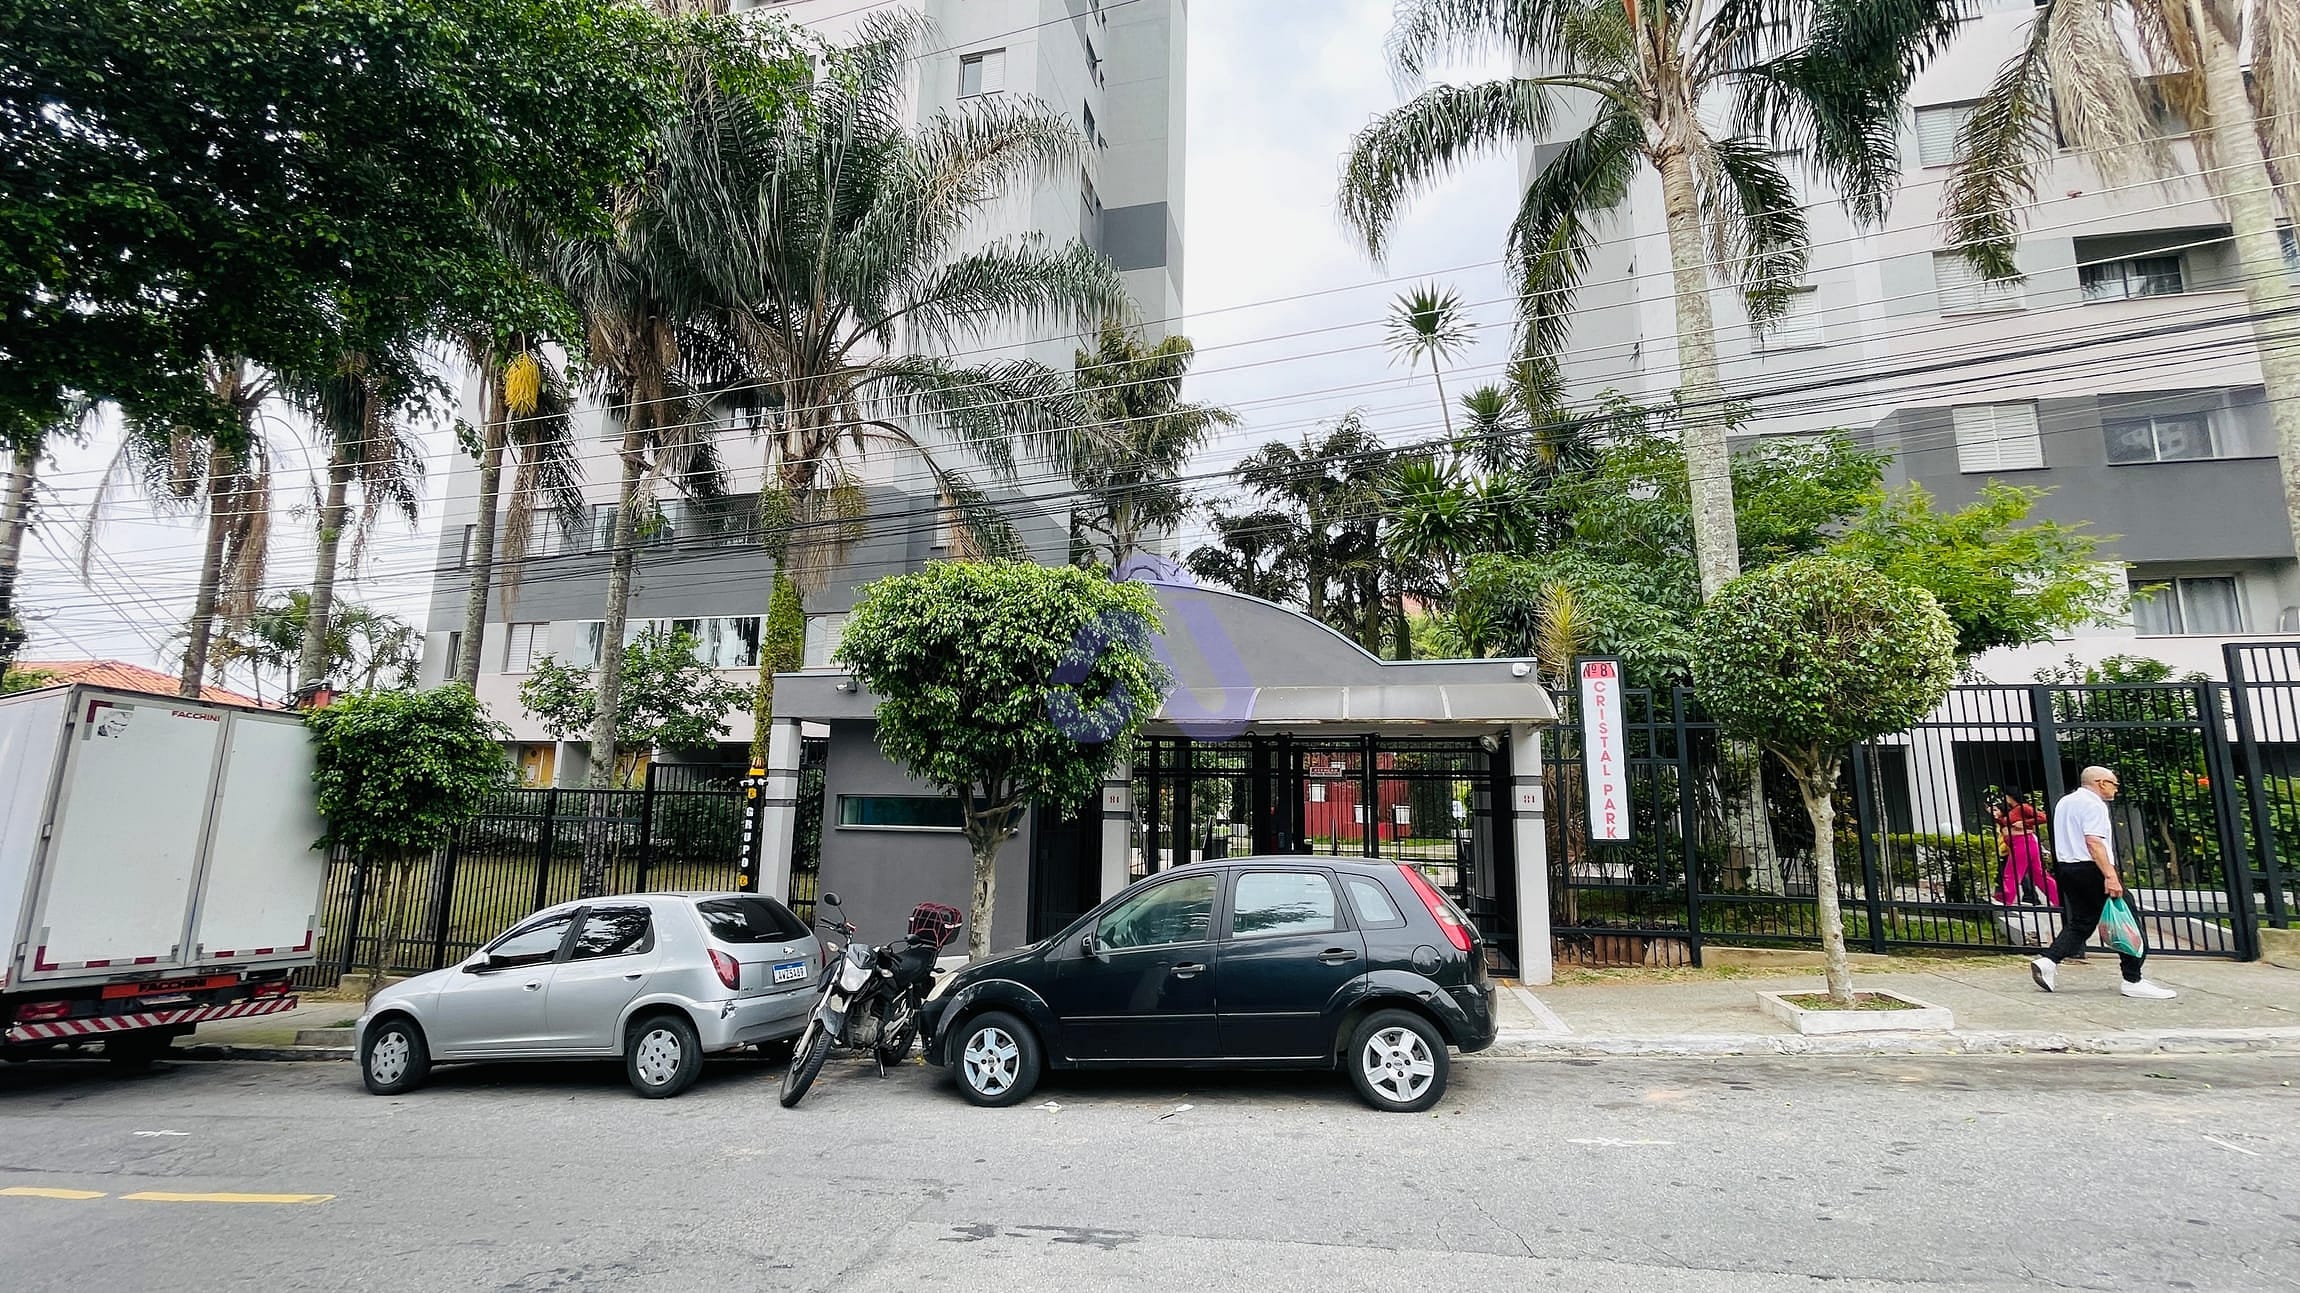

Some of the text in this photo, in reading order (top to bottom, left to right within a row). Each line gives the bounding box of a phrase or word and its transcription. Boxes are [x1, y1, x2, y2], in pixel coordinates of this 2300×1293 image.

[171, 710, 221, 722] FACCHINI
[1593, 680, 1617, 839] CRISTAL PARK
[741, 806, 754, 868] GRUPO
